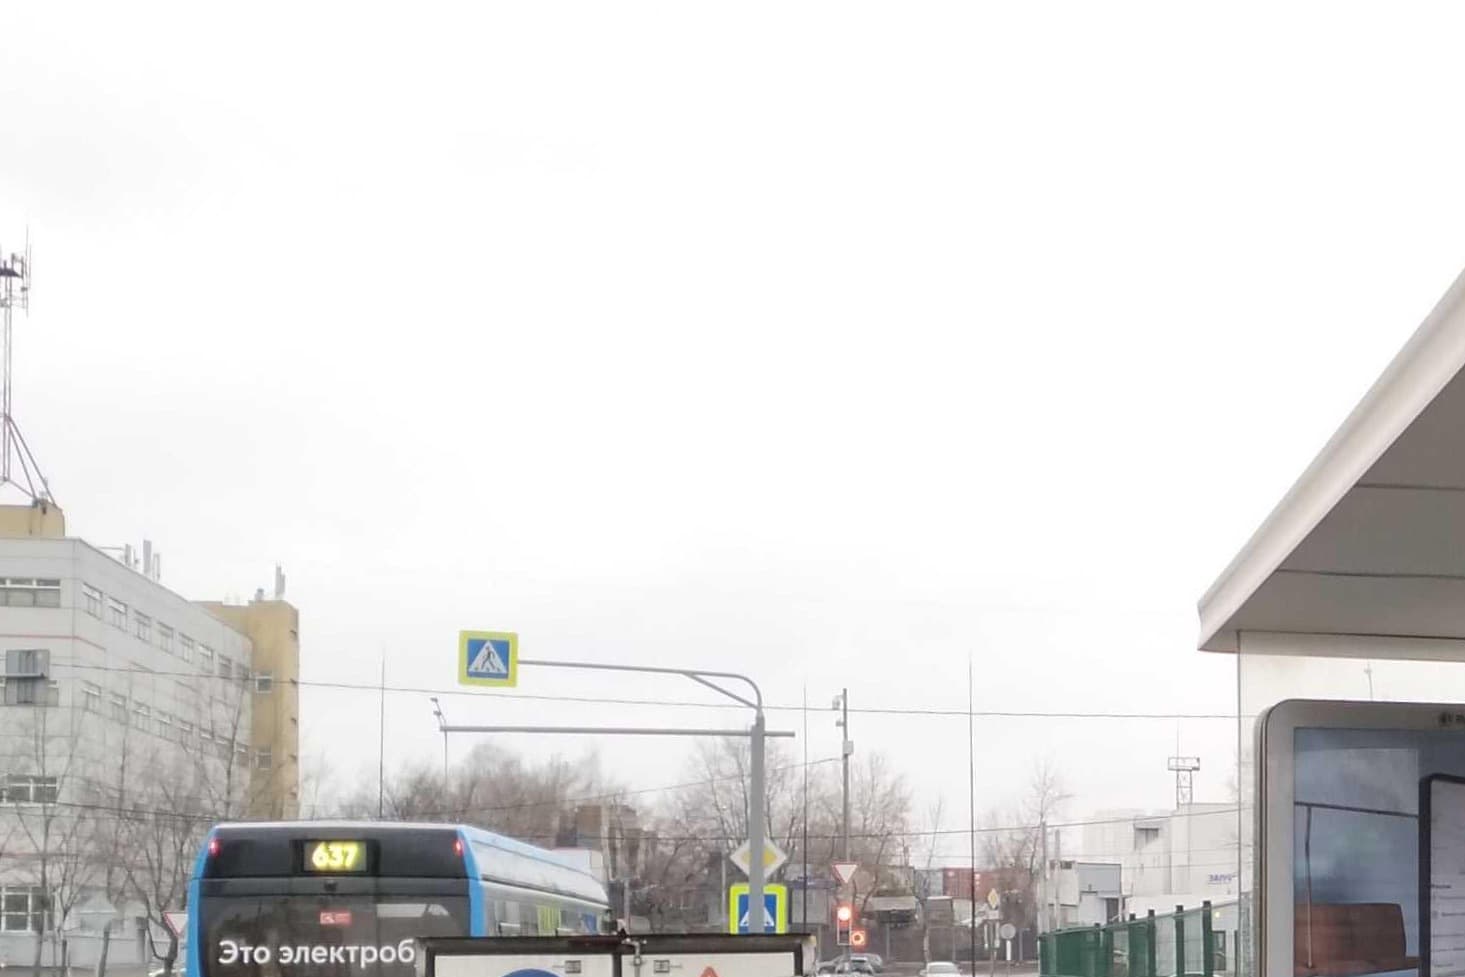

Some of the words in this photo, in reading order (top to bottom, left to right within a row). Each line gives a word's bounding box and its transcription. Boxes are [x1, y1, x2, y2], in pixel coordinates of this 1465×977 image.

[311, 841, 358, 869] 637
[218, 940, 271, 965] Это
[279, 938, 416, 969] электроб
